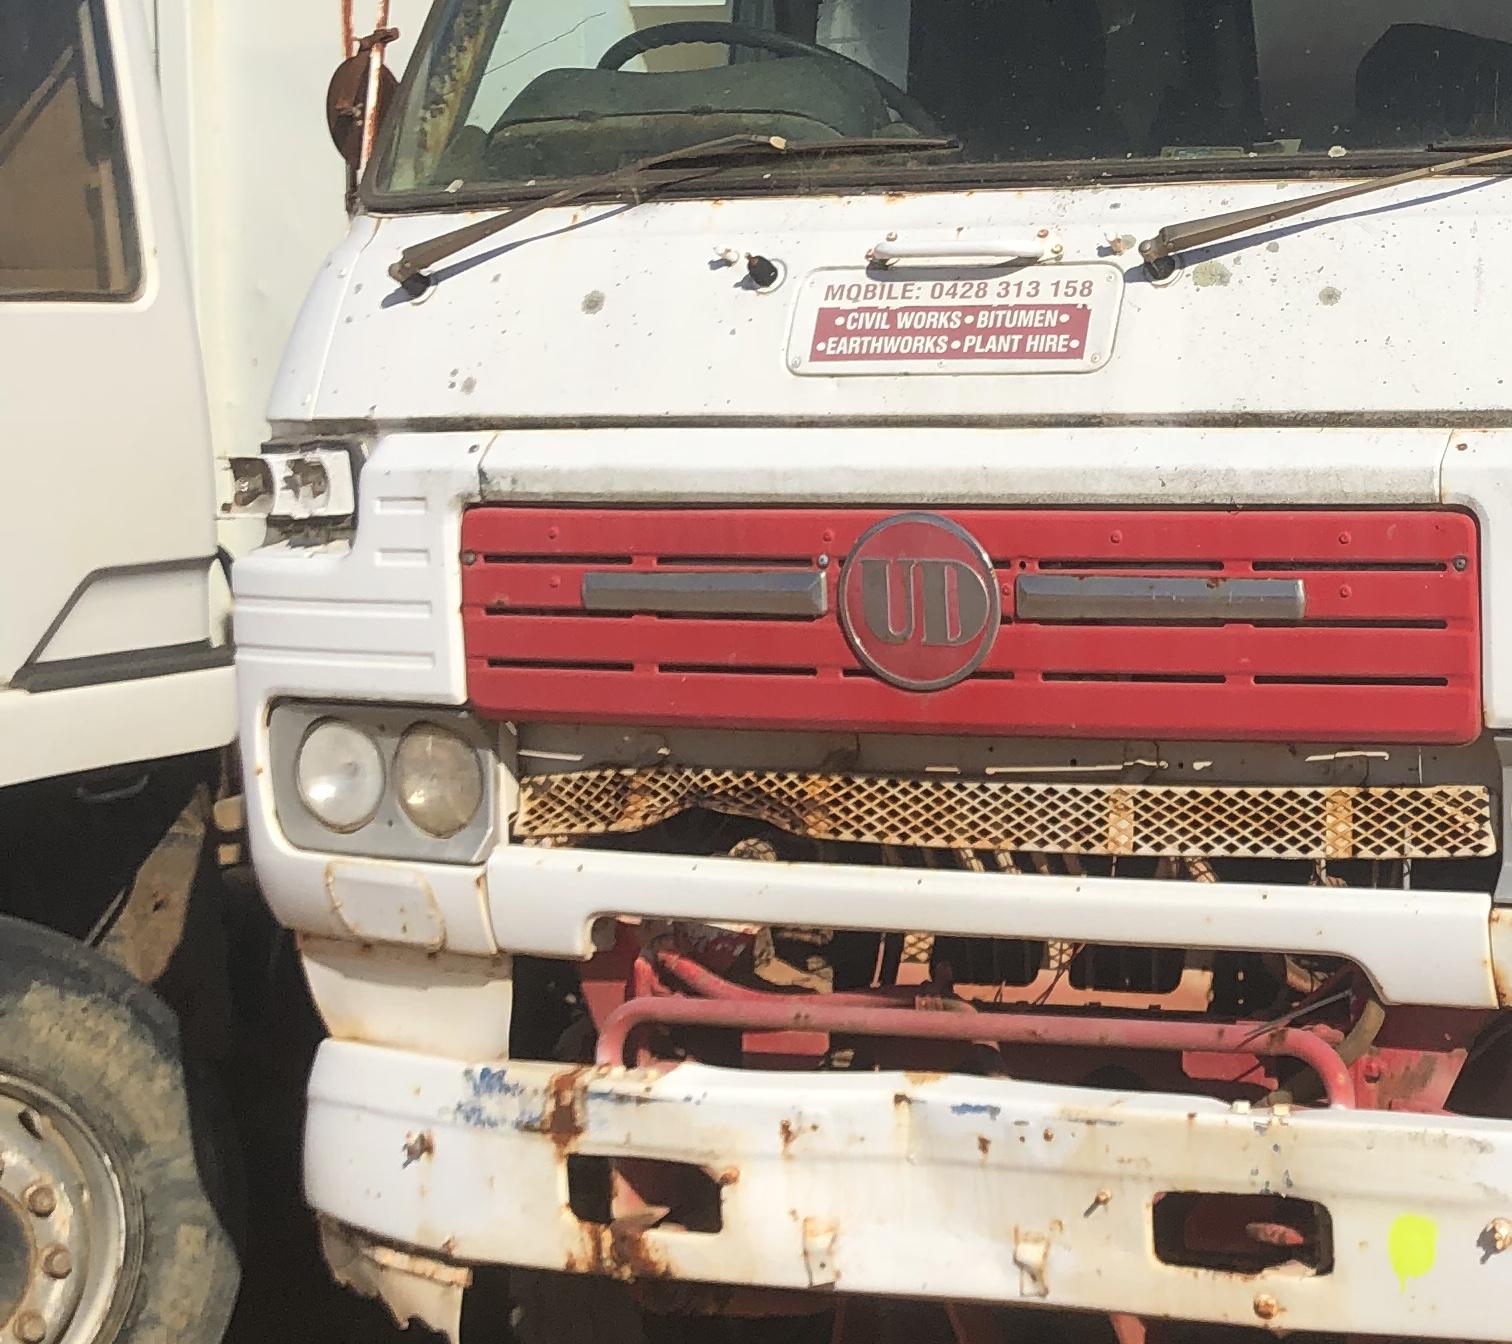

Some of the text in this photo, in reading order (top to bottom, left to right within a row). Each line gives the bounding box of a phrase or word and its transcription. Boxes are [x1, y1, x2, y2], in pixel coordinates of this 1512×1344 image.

[930, 282, 988, 299] 0428
[996, 280, 1041, 298] 313
[1050, 280, 1094, 298] 158
[859, 558, 990, 646] UD
